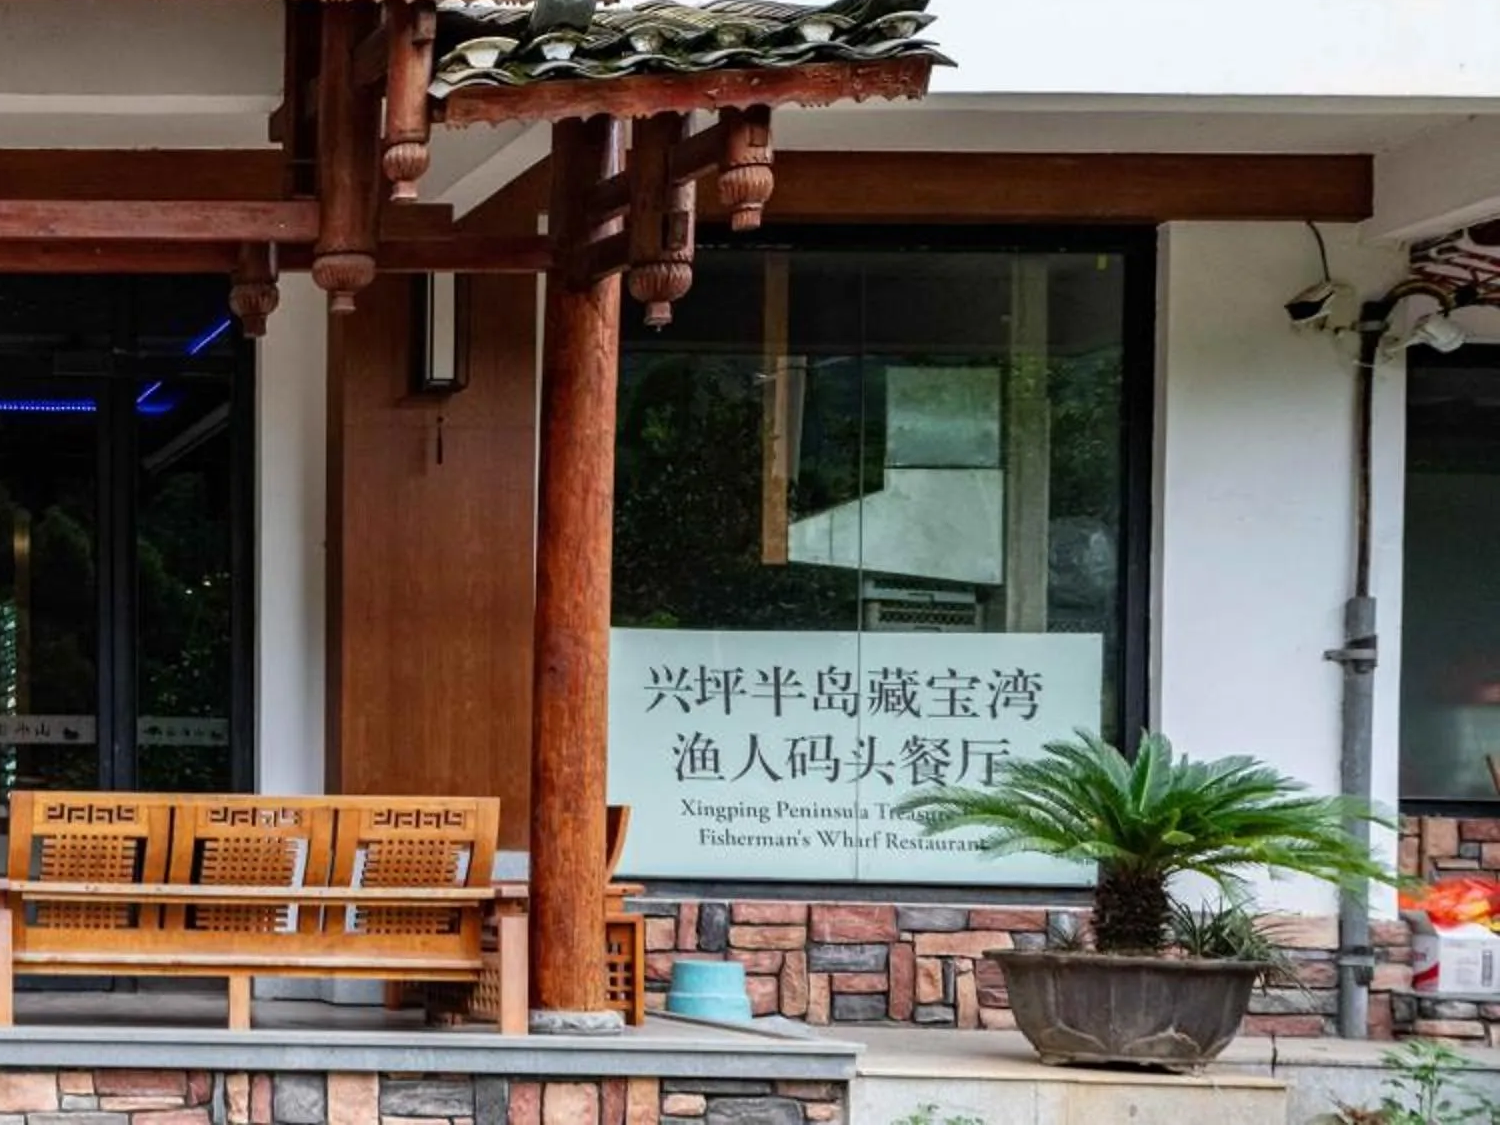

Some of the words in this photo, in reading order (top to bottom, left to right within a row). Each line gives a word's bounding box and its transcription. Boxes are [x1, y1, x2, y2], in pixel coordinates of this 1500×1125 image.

[643, 663, 1044, 720] 兴坪半岛藏宝湾
[672, 731, 1010, 787] 渔人码头餐厅
[681, 799, 771, 823] Xingping
[776, 800, 869, 820] Peninsula
[699, 828, 811, 847] Fisherman's
